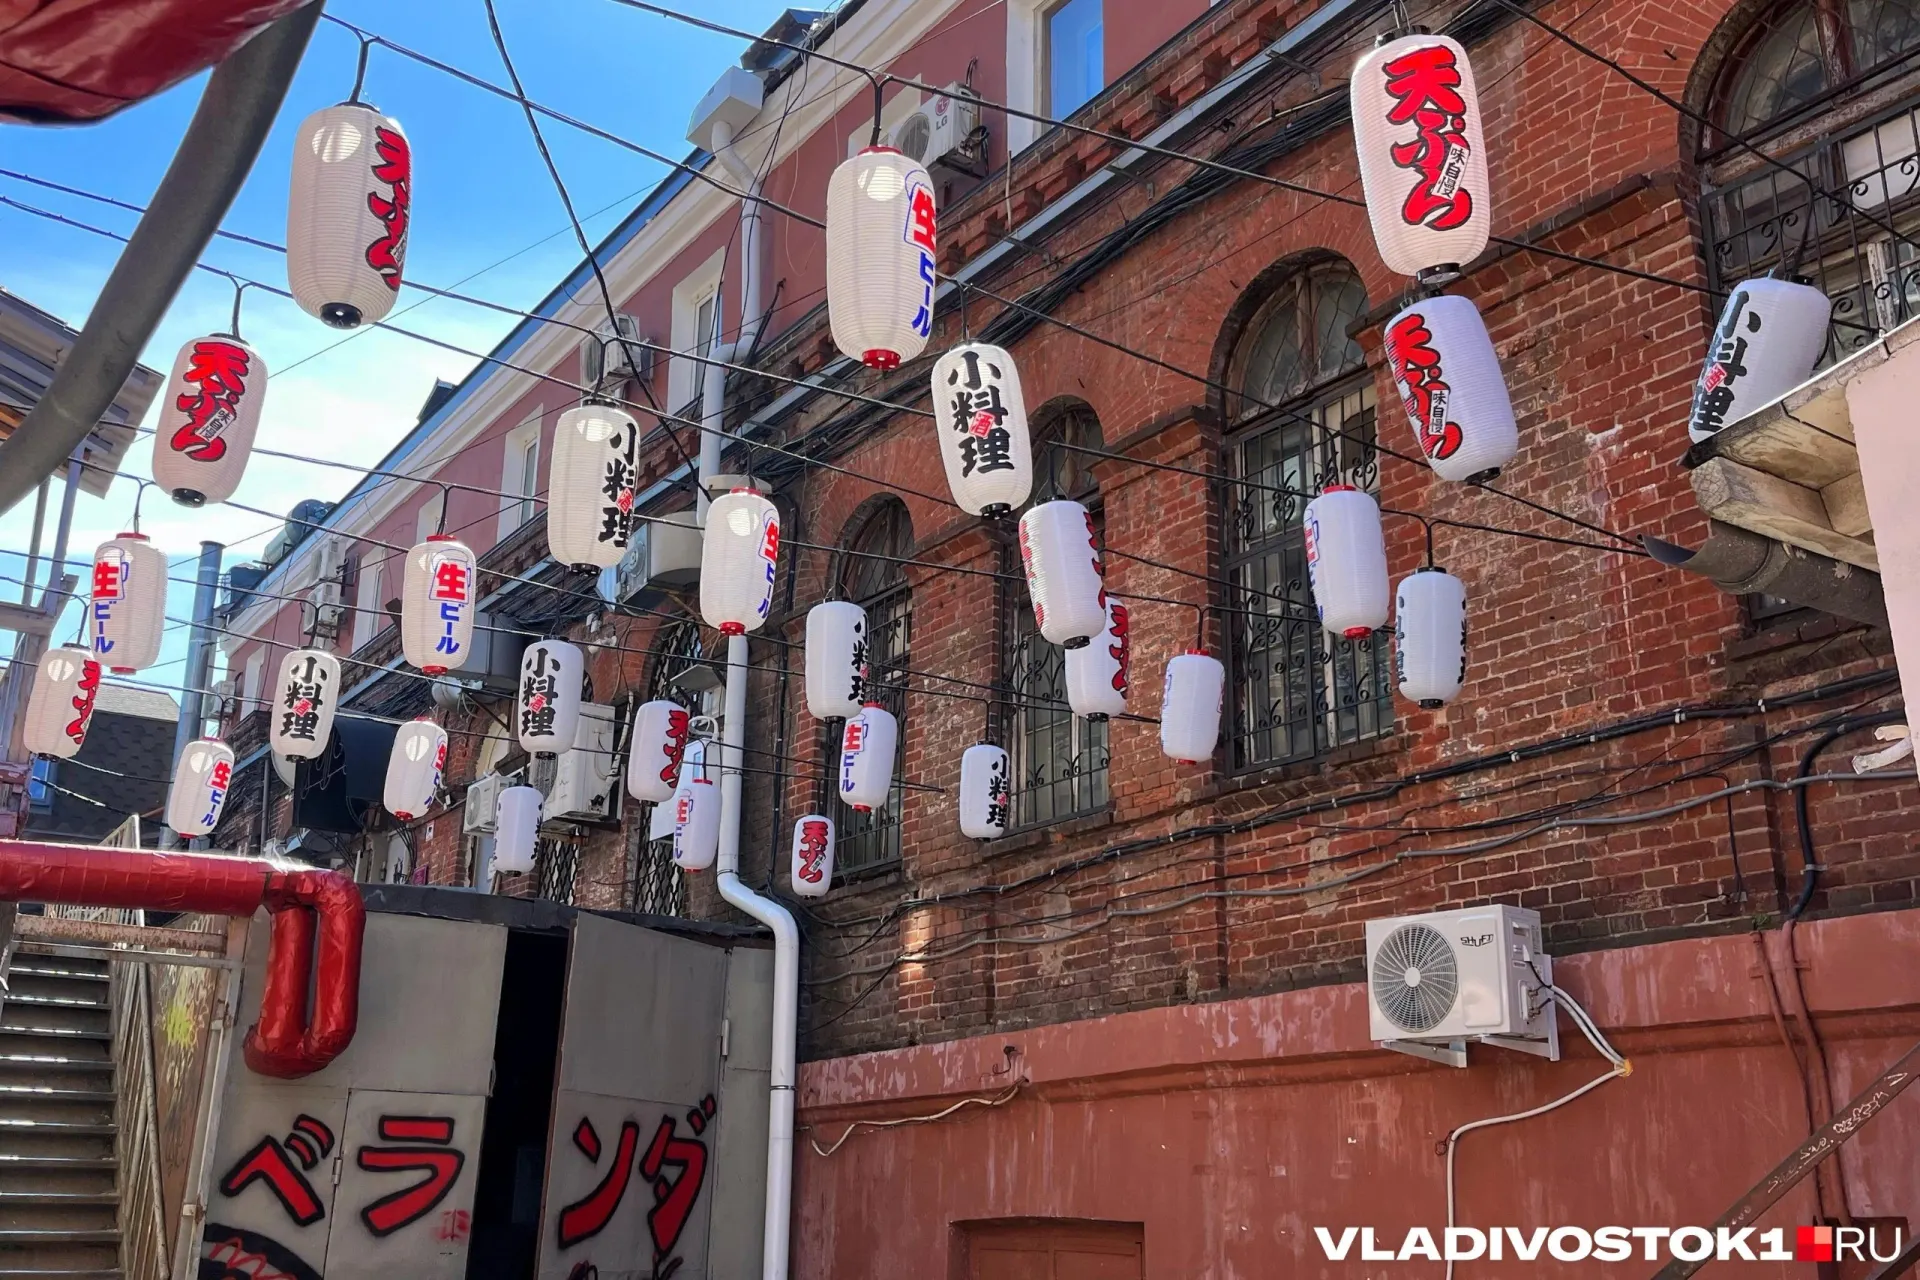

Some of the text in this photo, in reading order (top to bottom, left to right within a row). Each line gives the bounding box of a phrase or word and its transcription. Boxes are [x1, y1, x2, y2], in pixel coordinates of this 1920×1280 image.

[935, 114, 948, 131] LG
[1382, 44, 1472, 231] 天ぷら
[1432, 146, 1467, 198] 味自慢
[170, 341, 250, 462] 天ぷら
[947, 350, 1015, 478] 小料理
[1430, 389, 1447, 434] 味自慢
[93, 561, 120, 654] 生ビール
[435, 562, 466, 655] 生ビール
[279, 655, 328, 741] 小料理
[522, 647, 561, 737] 小料理
[200, 759, 232, 827] 生ビール
[842, 721, 862, 793] 生ビール
[798, 820, 829, 884] 天ぷら
[1459, 933, 1494, 948] SHUFT
